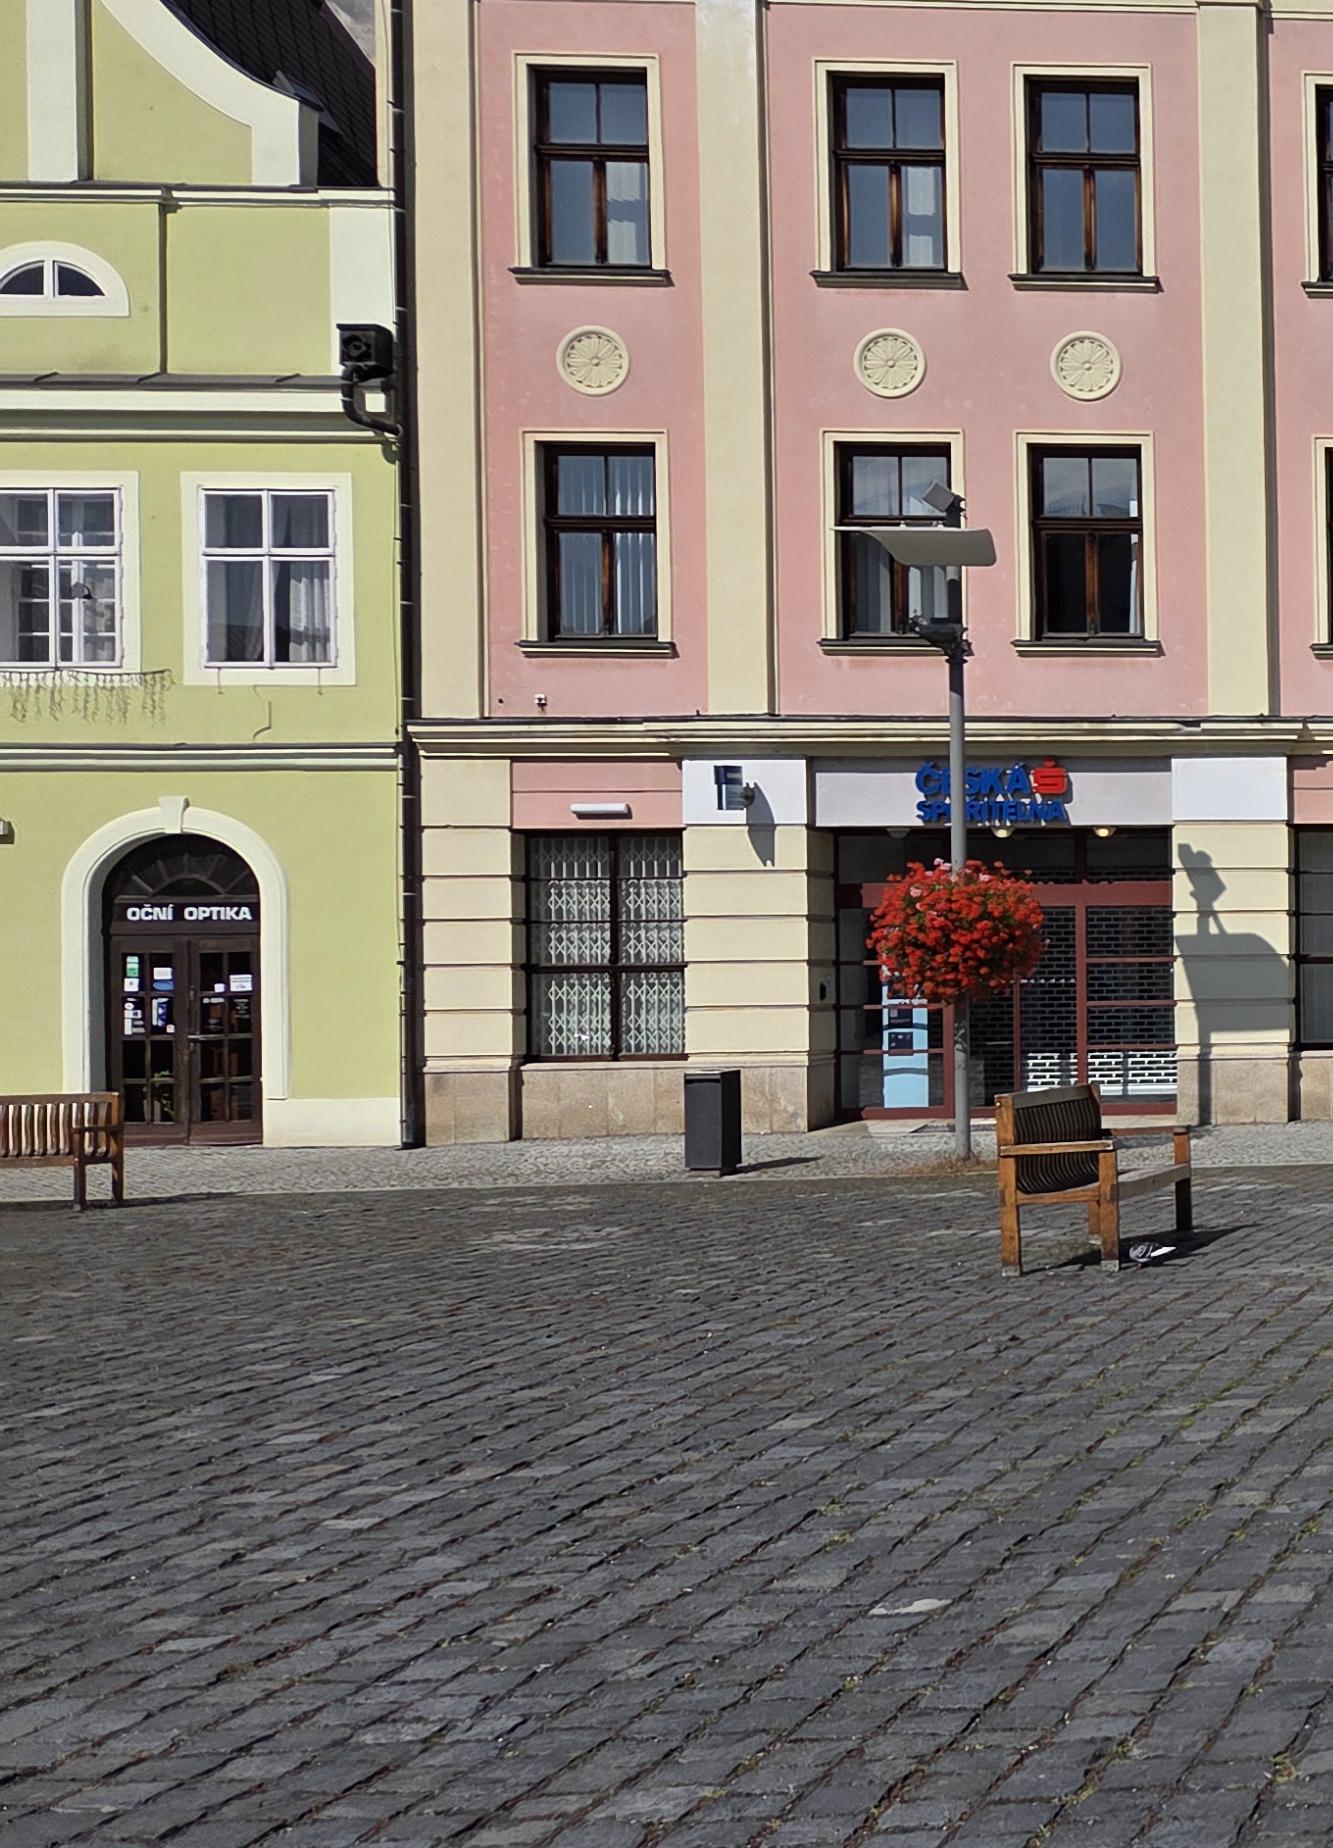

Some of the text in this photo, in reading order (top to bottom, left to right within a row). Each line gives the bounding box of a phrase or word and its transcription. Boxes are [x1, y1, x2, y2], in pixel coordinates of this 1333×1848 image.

[916, 797, 1067, 822] SPŘITELNA
[126, 903, 253, 921] OČNÍ OPTIKA
